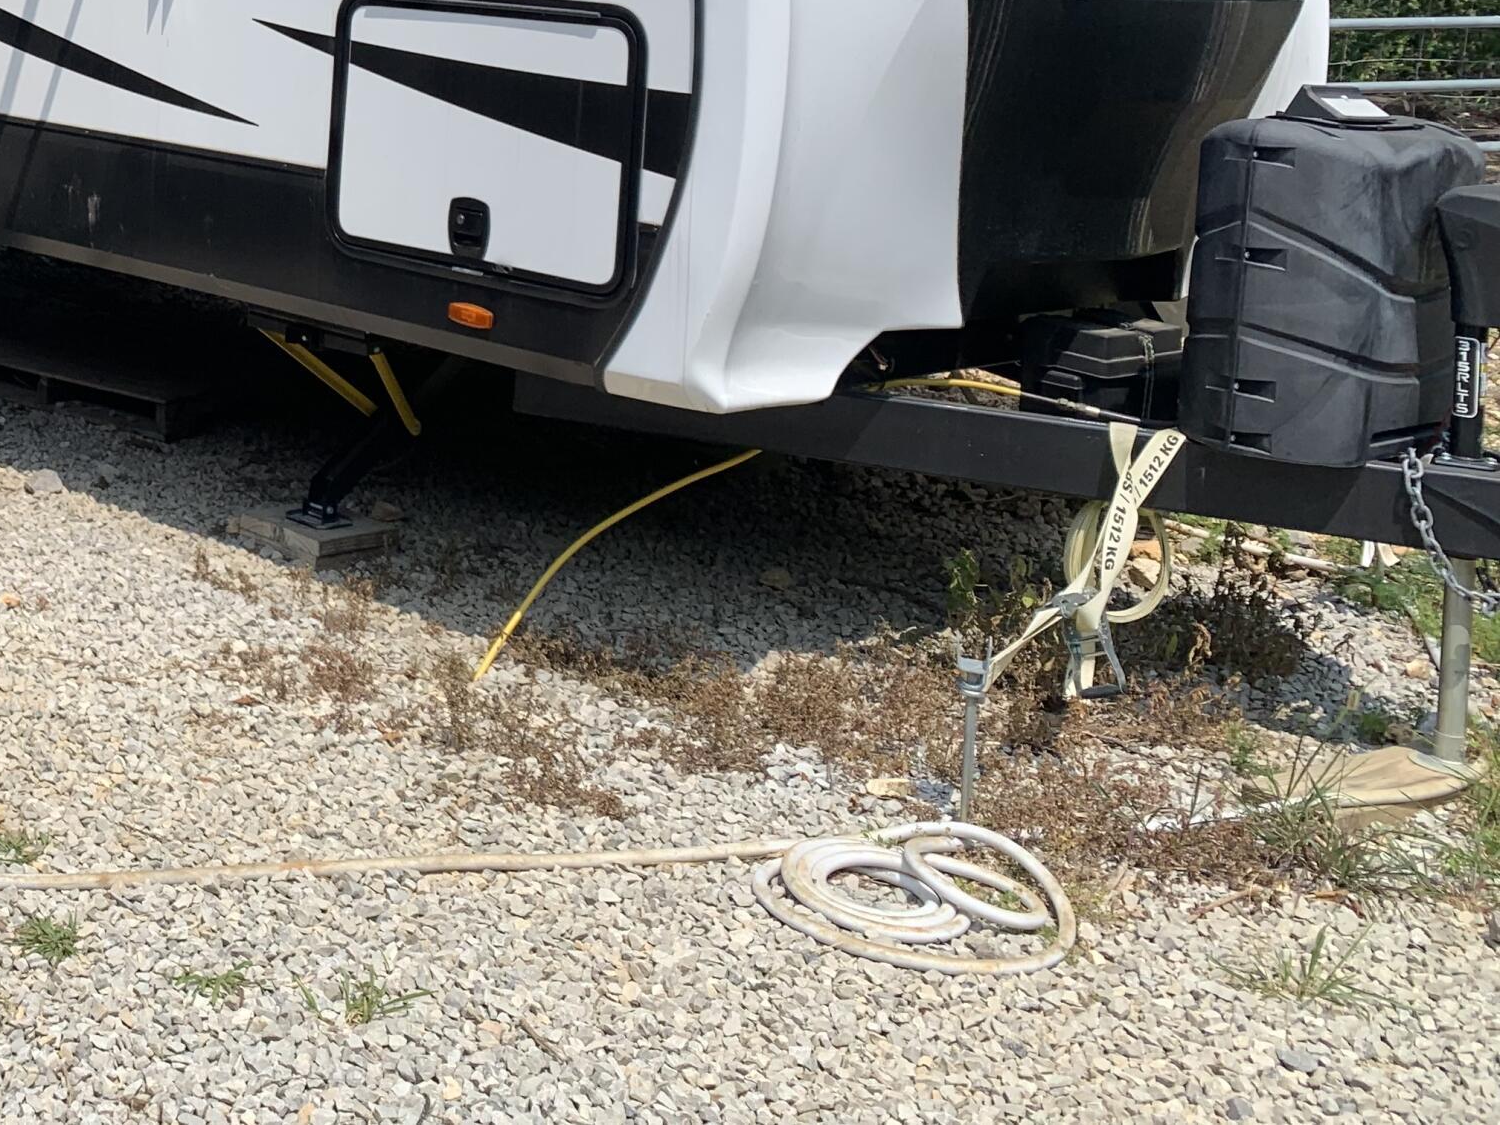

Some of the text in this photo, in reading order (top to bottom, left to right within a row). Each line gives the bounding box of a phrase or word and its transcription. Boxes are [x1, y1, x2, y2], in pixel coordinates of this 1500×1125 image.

[1139, 455, 1165, 488] 1512
[1159, 434, 1179, 456] KG
[1109, 505, 1126, 543] 1512
[1104, 546, 1118, 570] KG
